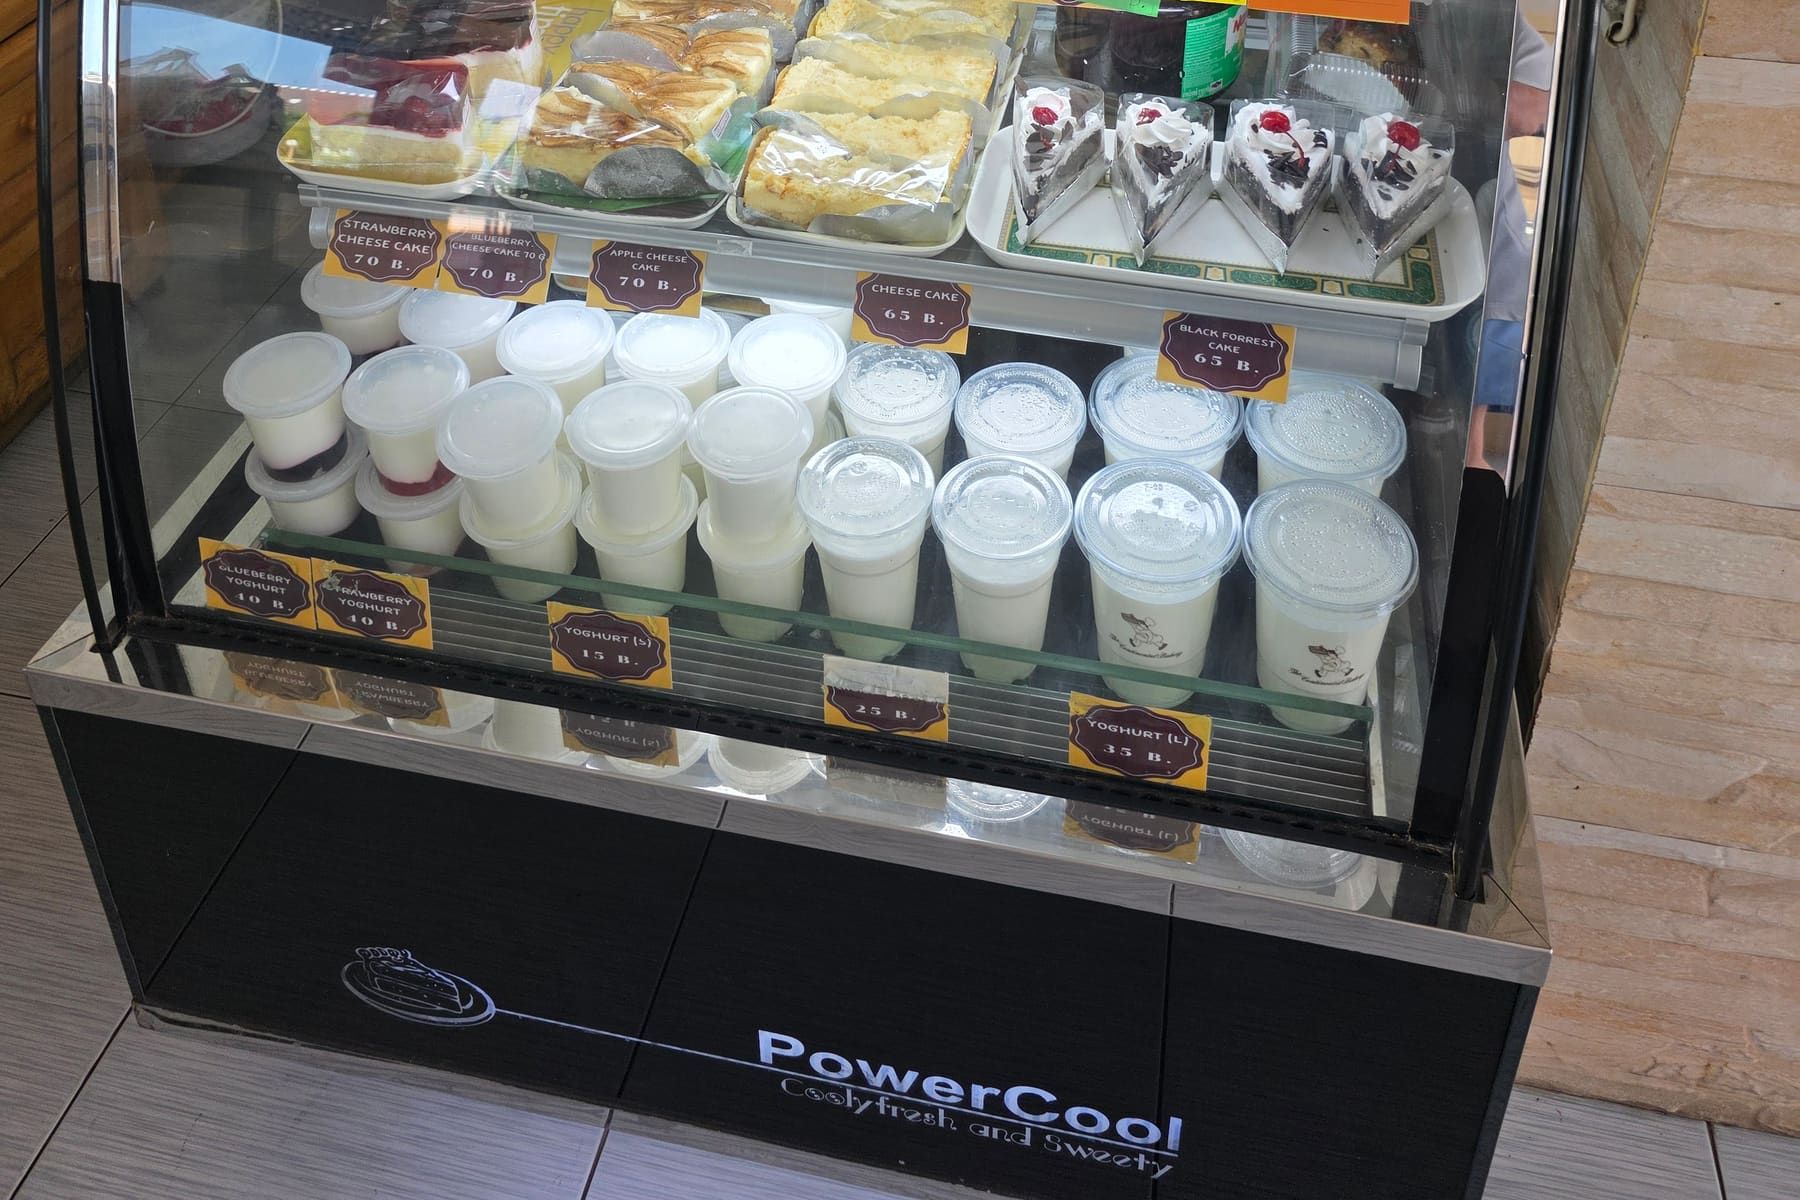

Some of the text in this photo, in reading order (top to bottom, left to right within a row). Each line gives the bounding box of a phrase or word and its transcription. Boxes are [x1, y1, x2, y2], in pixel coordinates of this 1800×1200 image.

[344, 218, 437, 240] STRAWBERRY
[338, 234, 431, 255] CHEESE CAKE
[452, 242, 492, 254] CHEESE
[494, 247, 521, 258] CAKE
[523, 251, 536, 260] 70
[353, 253, 411, 272] 70 B.
[610, 249, 688, 264] APPLE CHEESE
[469, 266, 524, 283] 70 B.
[631, 262, 661, 273] CAKE
[619, 276, 678, 291] 70 B.
[871, 283, 960, 302] CHEESE CAKE
[883, 307, 944, 326] 65 B.
[1178, 323, 1277, 349] BLACK FORREST
[1207, 341, 1241, 355] CAKE
[1193, 351, 1260, 374] 65 B.
[226, 576, 287, 595] YOGHURT
[331, 585, 413, 606] TRAWBERRY
[338, 597, 401, 616] YOGHURT
[564, 626, 629, 643] YOGHURT
[583, 649, 605, 660] 15
[855, 704, 917, 721] 25 B.
[1085, 717, 1189, 747] YOGHURT (L)
[1103, 743, 1172, 764] 35 B.
[757, 1029, 1183, 1151] PowerCool
[968, 1121, 1032, 1147] and
[1043, 1133, 1175, 1180] Sweety
